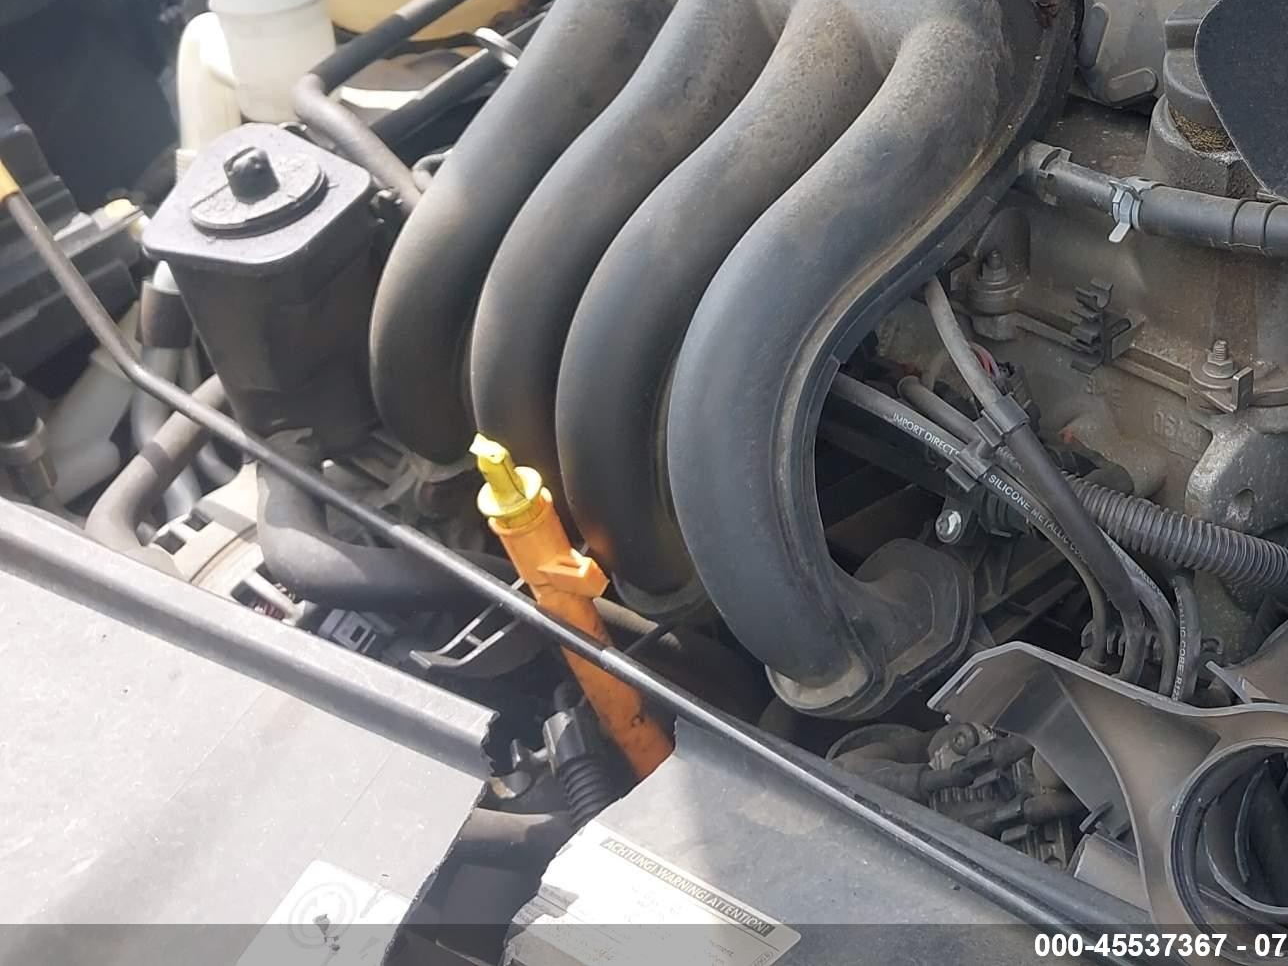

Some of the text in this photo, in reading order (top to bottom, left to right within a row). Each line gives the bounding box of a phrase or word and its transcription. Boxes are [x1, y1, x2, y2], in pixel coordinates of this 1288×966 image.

[891, 412, 924, 436] IMPORT
[989, 473, 1032, 511] SILICONE
[1031, 508, 1070, 543] METALLIC
[1176, 639, 1186, 672] CORE
[603, 839, 769, 935] ACHTUNG! WARNING! ATTENTION!
